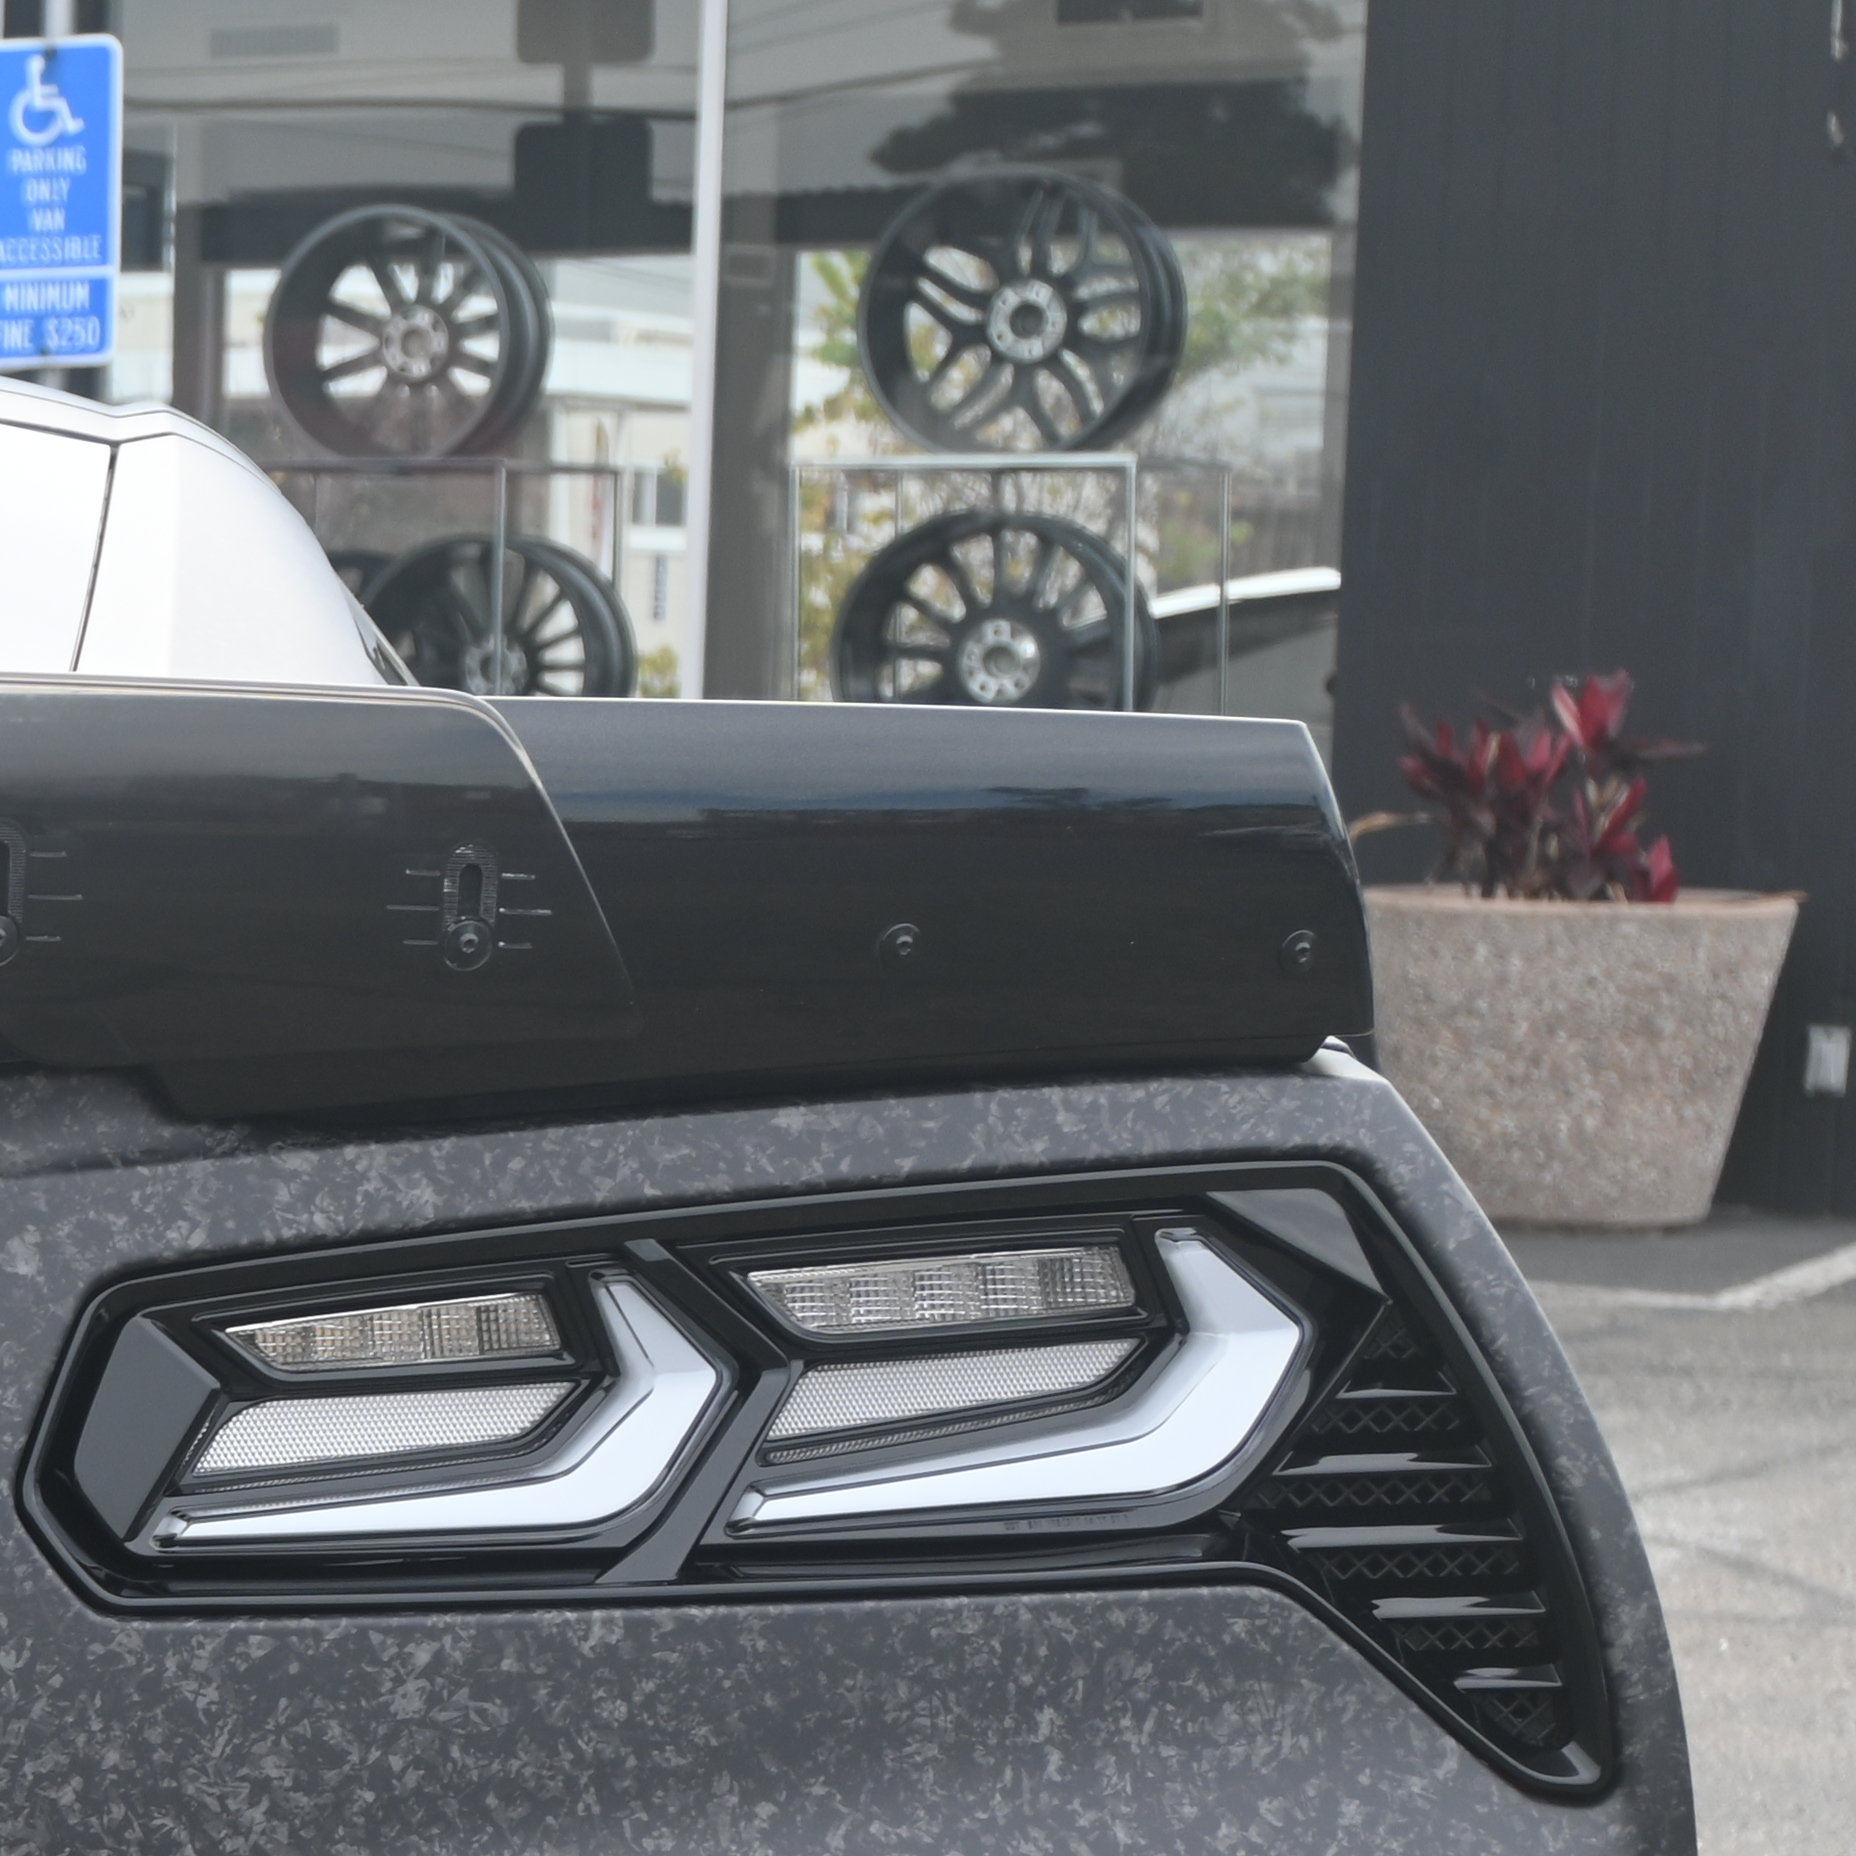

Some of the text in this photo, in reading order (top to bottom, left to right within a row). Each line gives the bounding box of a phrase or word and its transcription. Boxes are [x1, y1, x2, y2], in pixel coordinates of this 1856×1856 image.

[10, 147, 88, 174] PARKING
[24, 177, 70, 202] ONLY
[31, 207, 66, 231] VAN
[3, 281, 90, 311] MINIMUM
[46, 316, 101, 349] $250
